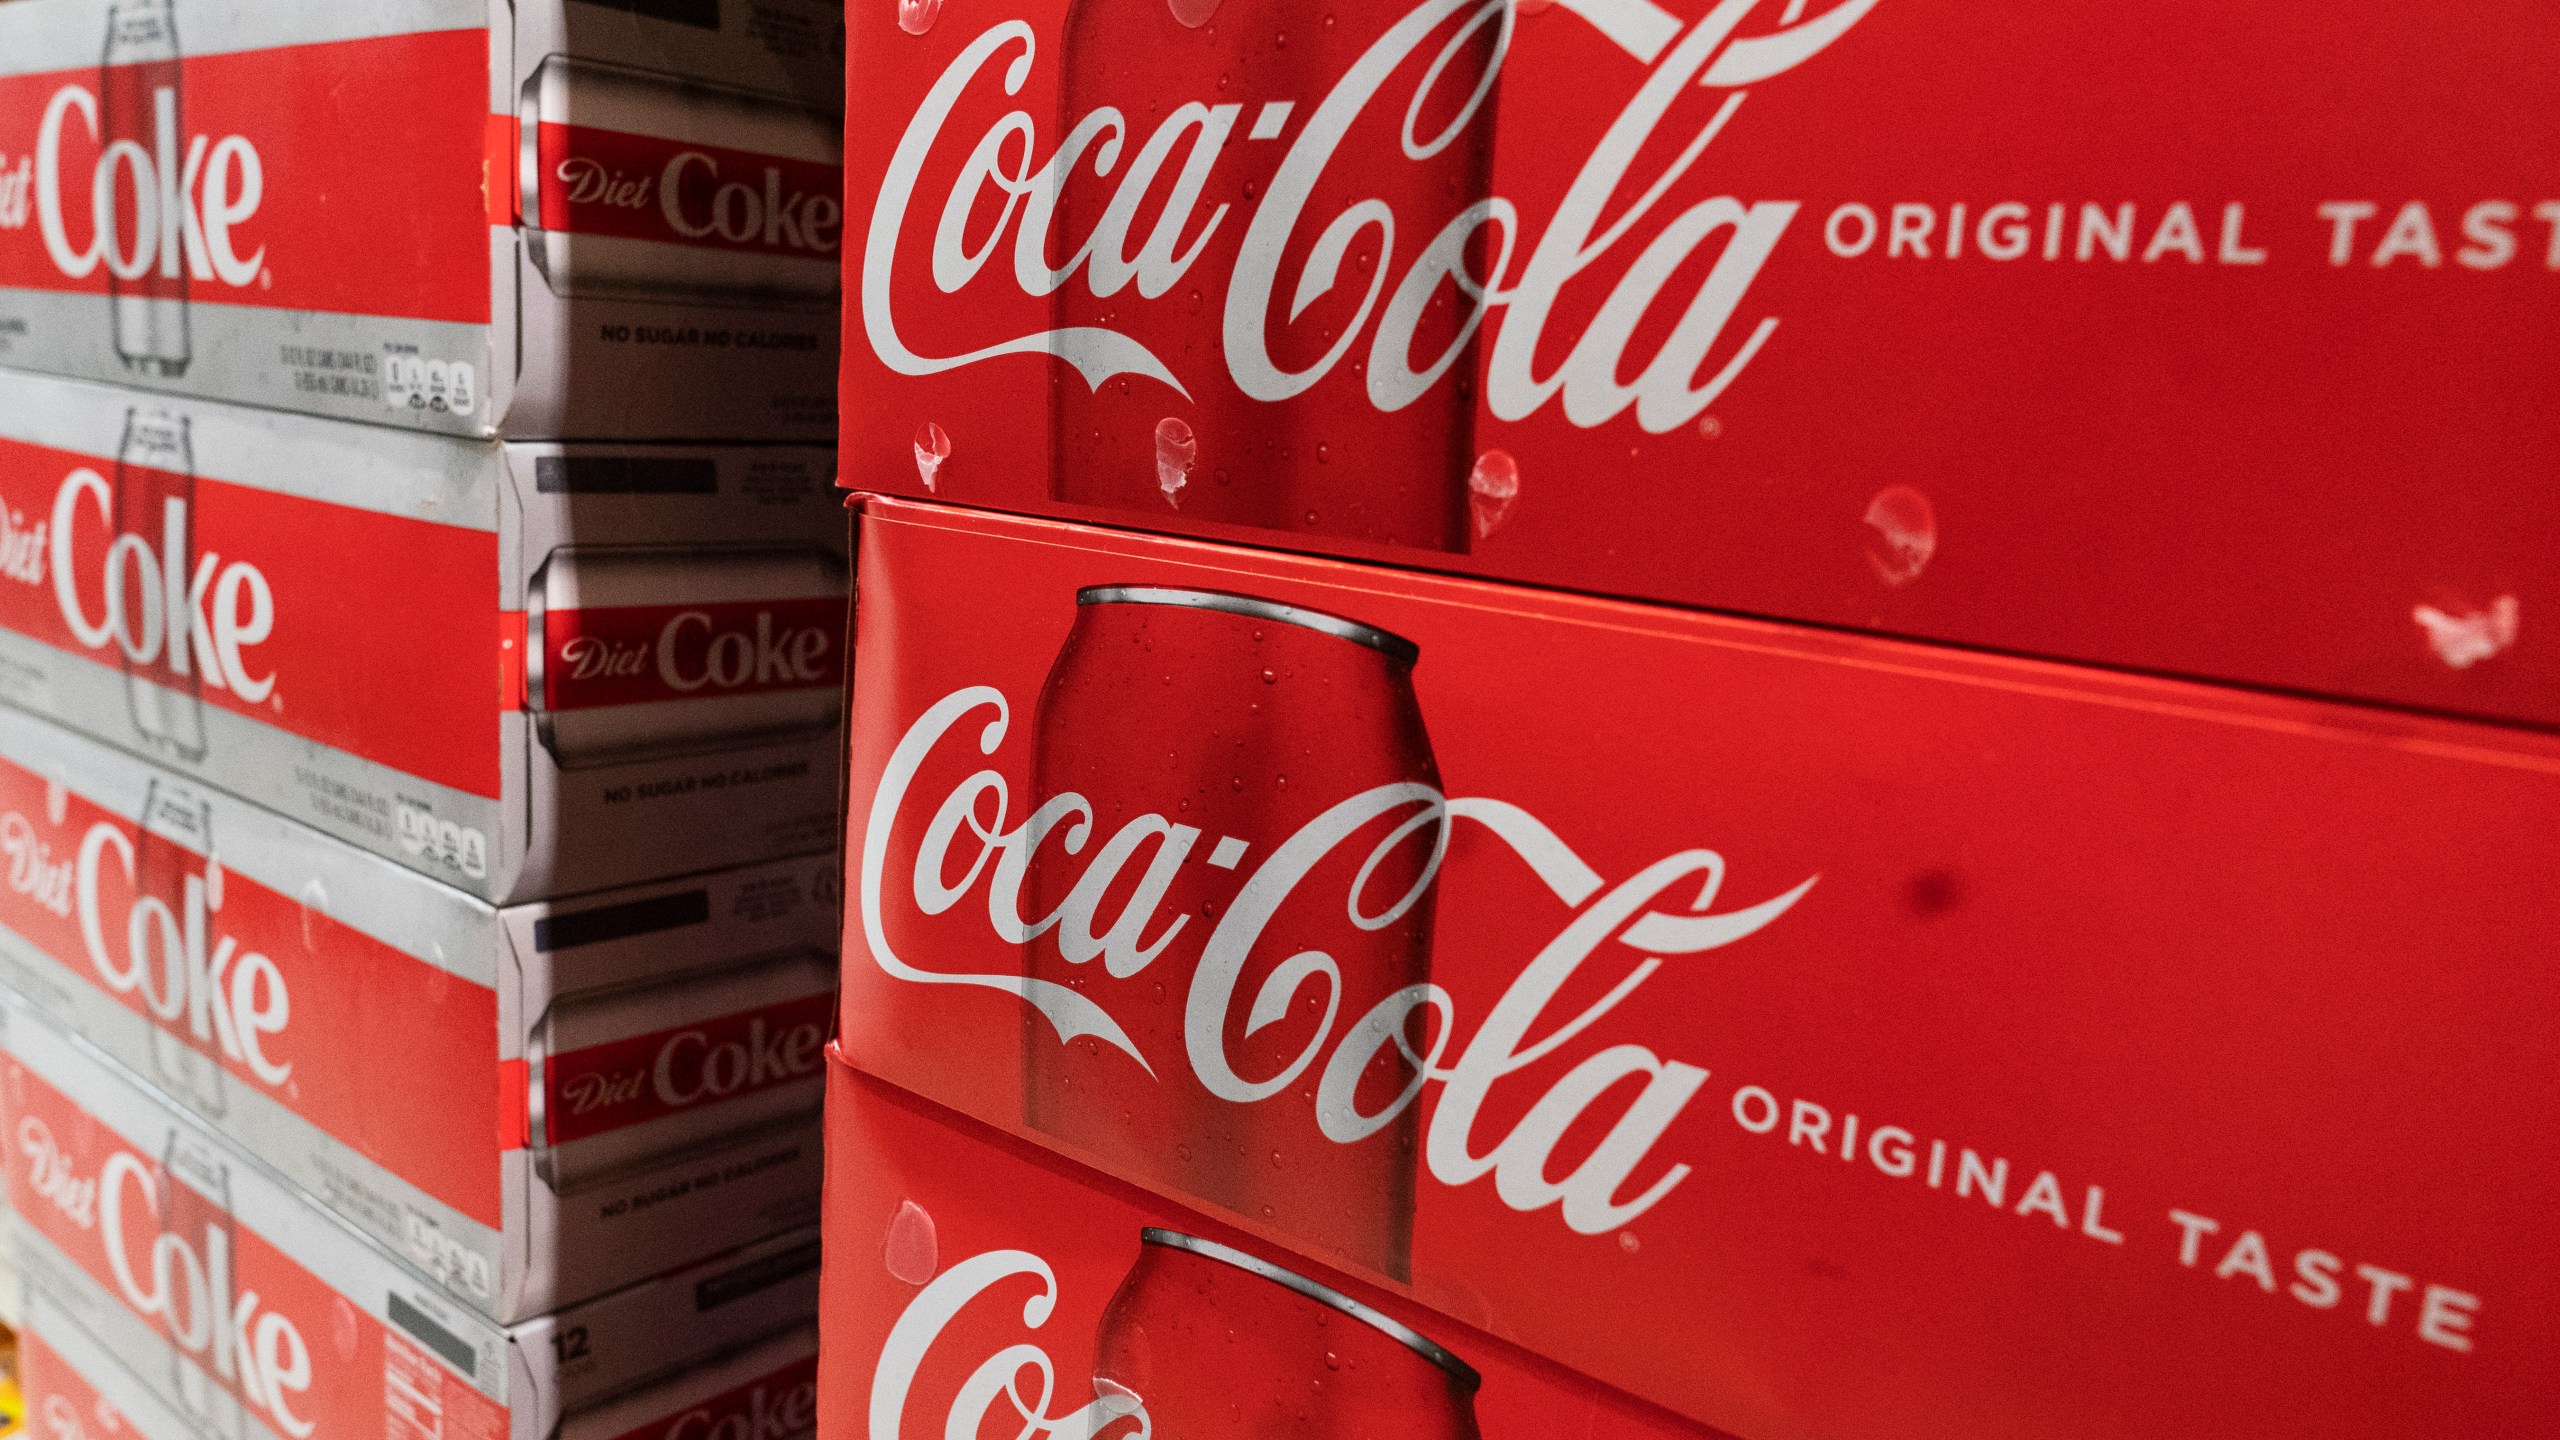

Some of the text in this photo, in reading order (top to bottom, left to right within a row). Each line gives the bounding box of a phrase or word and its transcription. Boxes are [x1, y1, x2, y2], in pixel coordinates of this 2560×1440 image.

[36, 85, 265, 287] Coke
[557, 151, 841, 253] Diet Coke
[862, 0, 1888, 433] Coca-Cola
[1824, 201, 2267, 264] ORIGINAL
[601, 325, 630, 342] NO
[635, 326, 699, 345] SUGAR
[52, 468, 276, 703] Coke
[561, 611, 828, 692] Diet Coke
[604, 787, 632, 804] NO
[637, 777, 696, 799] SUGAR
[77, 823, 293, 1085] Coke
[861, 685, 1821, 1234] Coca-Cola
[562, 1016, 822, 1116] Diet Coke
[101, 1152, 315, 1438] Coke
[1732, 1086, 2481, 1353] ORIGINAL TASTE
[551, 1326, 590, 1363] 12
